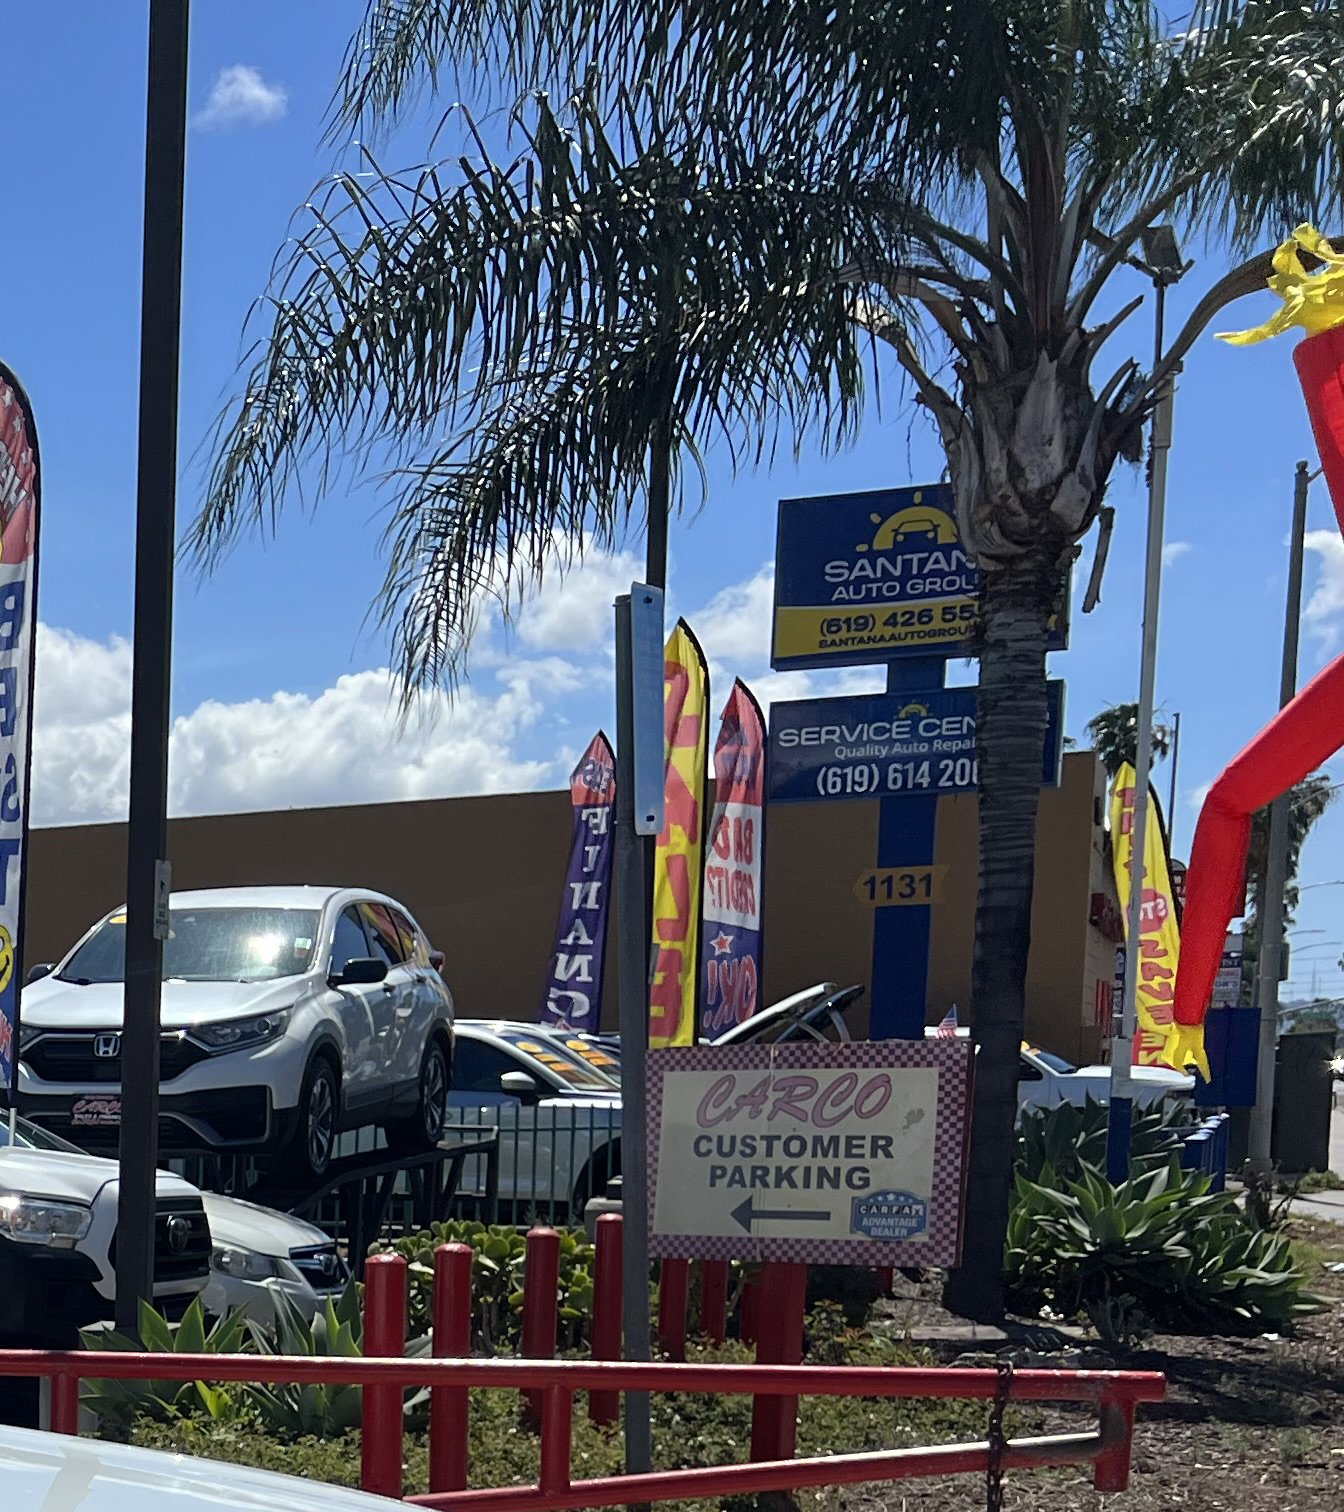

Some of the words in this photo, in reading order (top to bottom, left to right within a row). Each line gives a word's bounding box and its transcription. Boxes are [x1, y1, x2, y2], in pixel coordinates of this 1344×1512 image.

[824, 550, 976, 583] SANTAN
[831, 582, 900, 601] AUTO
[906, 575, 979, 594] GROU
[820, 614, 876, 637] (619)
[883, 608, 934, 628] 426
[941, 603, 980, 623] 55
[778, 720, 912, 747] SERVICE
[918, 715, 976, 737] CEN
[834, 744, 891, 760] Quality
[891, 742, 929, 754] Auto
[933, 737, 977, 754] Repai
[816, 764, 880, 797] (619)
[887, 760, 931, 791] 614
[938, 758, 978, 787] 20
[862, 873, 932, 900] 1131
[696, 1072, 893, 1129] CARCO
[693, 1134, 895, 1160] CUSTOMER
[708, 1164, 871, 1191] PARKING
[859, 1204, 924, 1216] CARFAX
